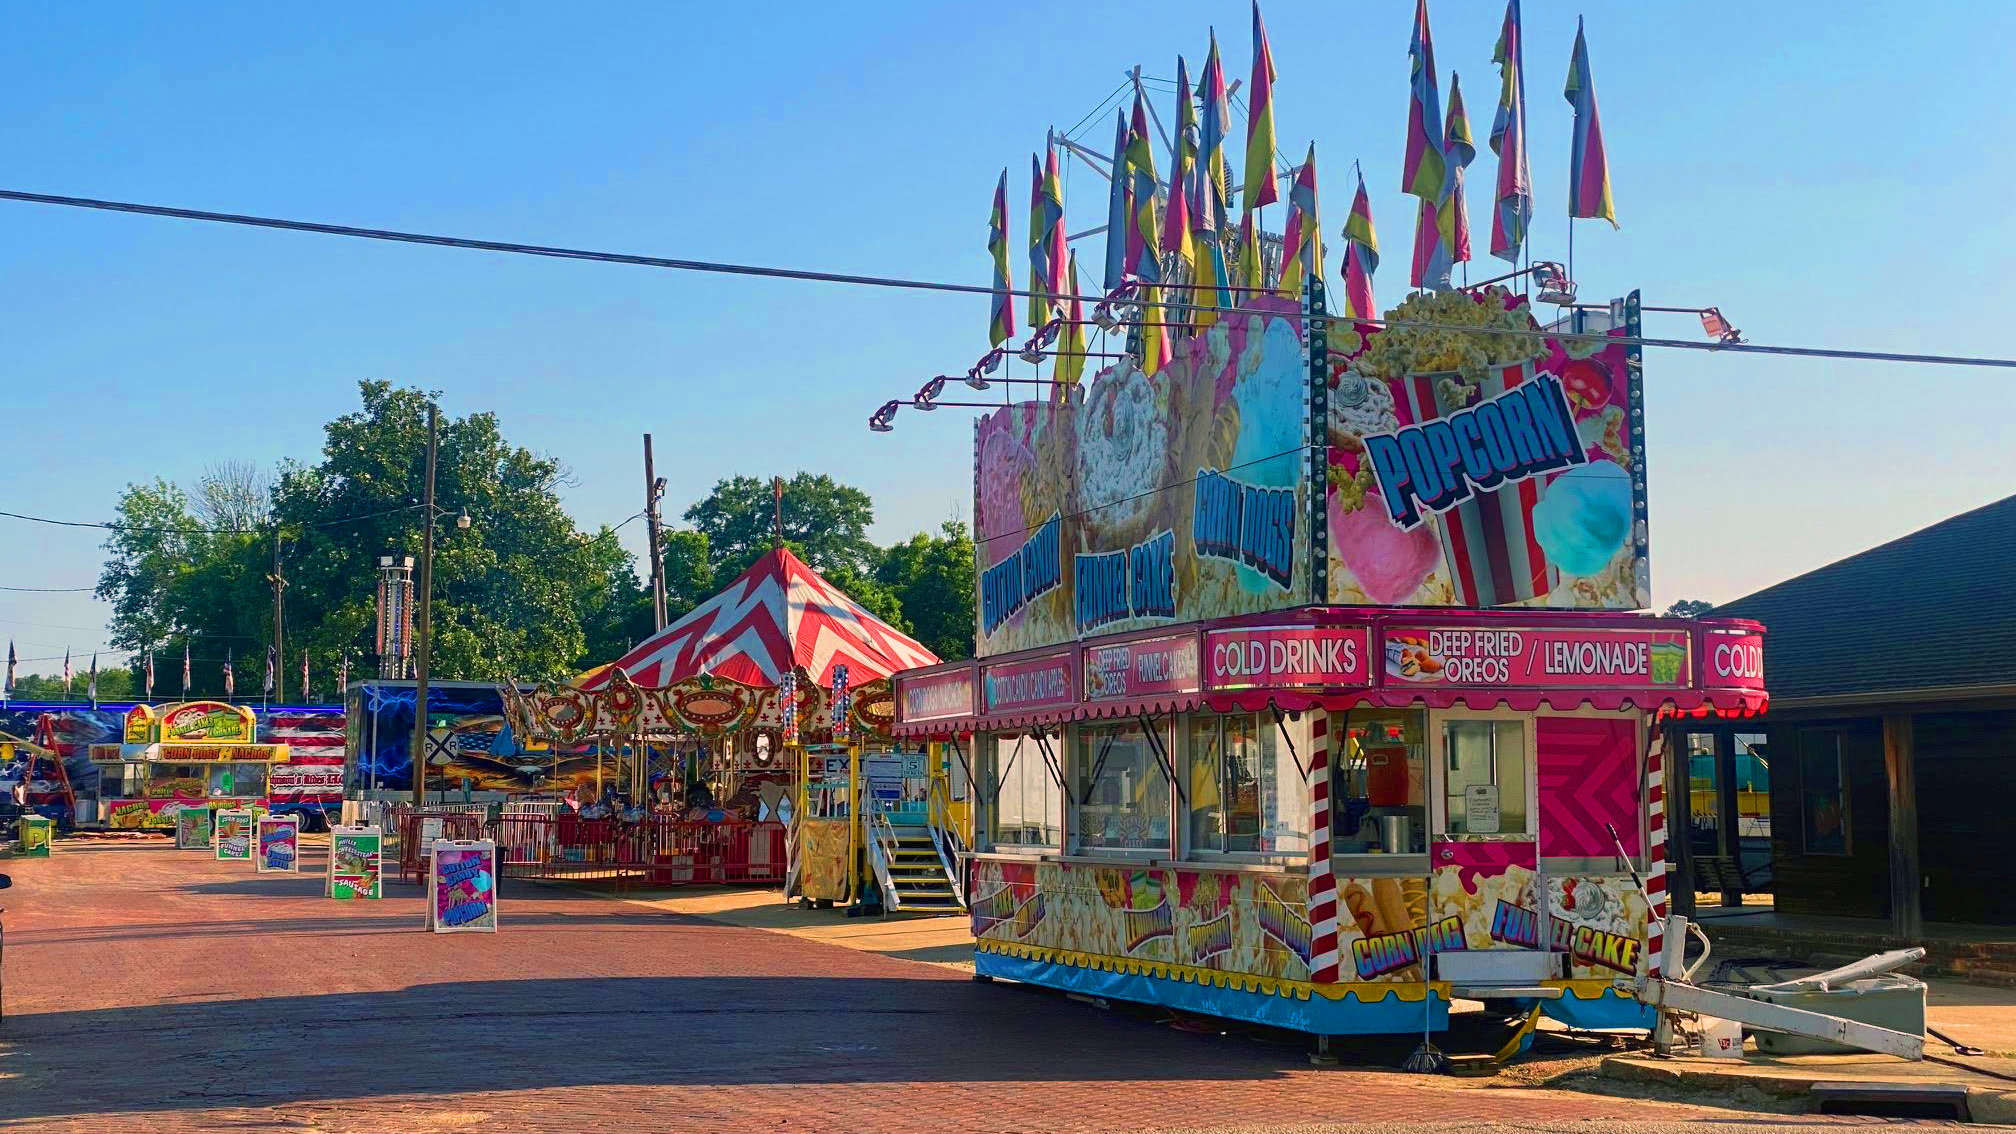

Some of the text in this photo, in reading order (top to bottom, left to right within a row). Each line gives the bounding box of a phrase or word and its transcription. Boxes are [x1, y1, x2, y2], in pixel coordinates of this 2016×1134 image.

[1363, 371, 1588, 531] POPCORN
[1195, 470, 1295, 591] CORN DOGS
[1075, 530, 1175, 637] FUNNEL CAKE
[1213, 639, 1357, 677] COLD DRINKS
[1429, 631, 1523, 657] DEEP FRIED
[1544, 642, 1648, 674] LEMONADE
[1098, 647, 1131, 671] DEEP FRIED
[1138, 651, 1186, 682] FUNNEL CAKES
[1443, 658, 1510, 683] OREOS
[1714, 643, 1757, 678] COLD
[1103, 672, 1127, 695] OREOS
[164, 748, 271, 759] CORN DOGS NACHOS
[425, 741, 457, 753] R R
[825, 758, 866, 772] EXT
[909, 761, 917, 769] 5
[339, 880, 374, 895] SAUSAGE
[1352, 915, 1468, 981] CORN DOG
[1490, 898, 1642, 977] FUNEL CAKE
